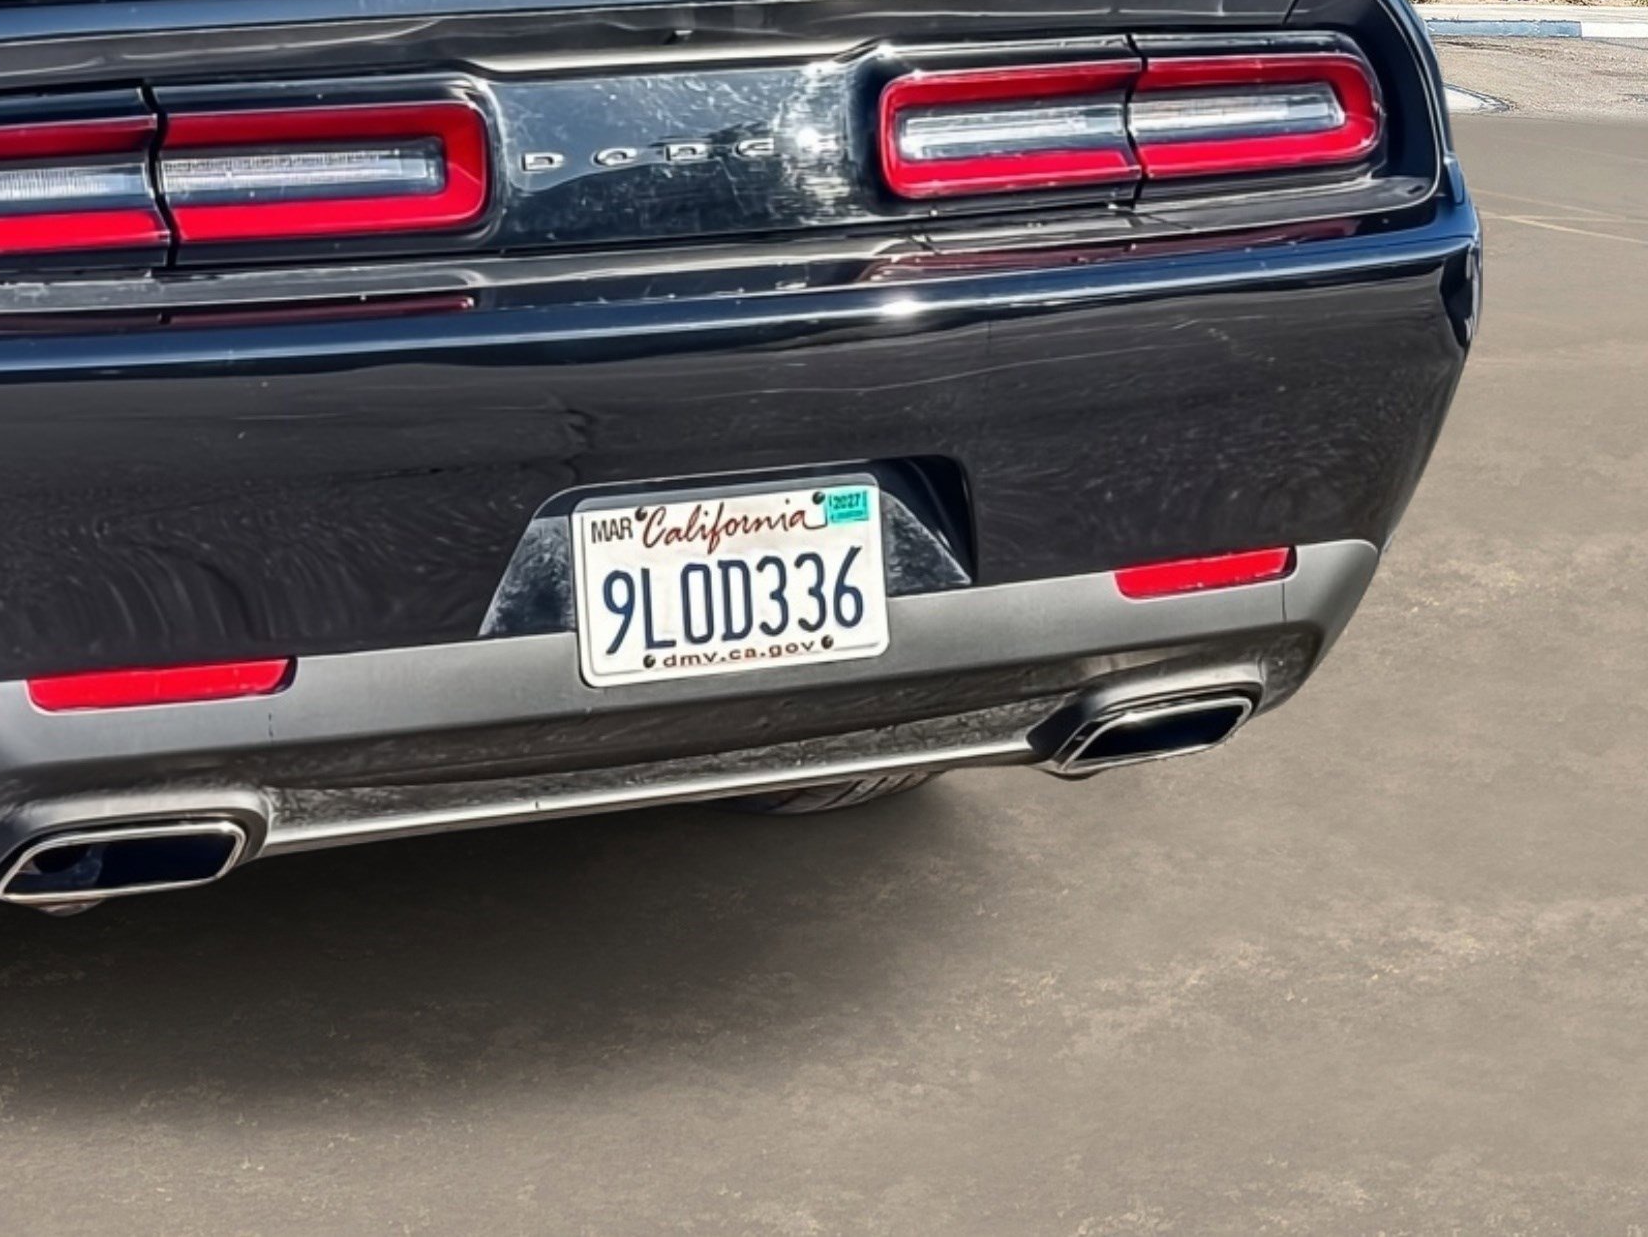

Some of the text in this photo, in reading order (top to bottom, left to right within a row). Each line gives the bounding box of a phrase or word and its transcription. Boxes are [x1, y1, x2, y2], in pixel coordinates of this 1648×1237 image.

[591, 500, 827, 555] MAR California
[663, 641, 815, 668] dmv.ca.gov
